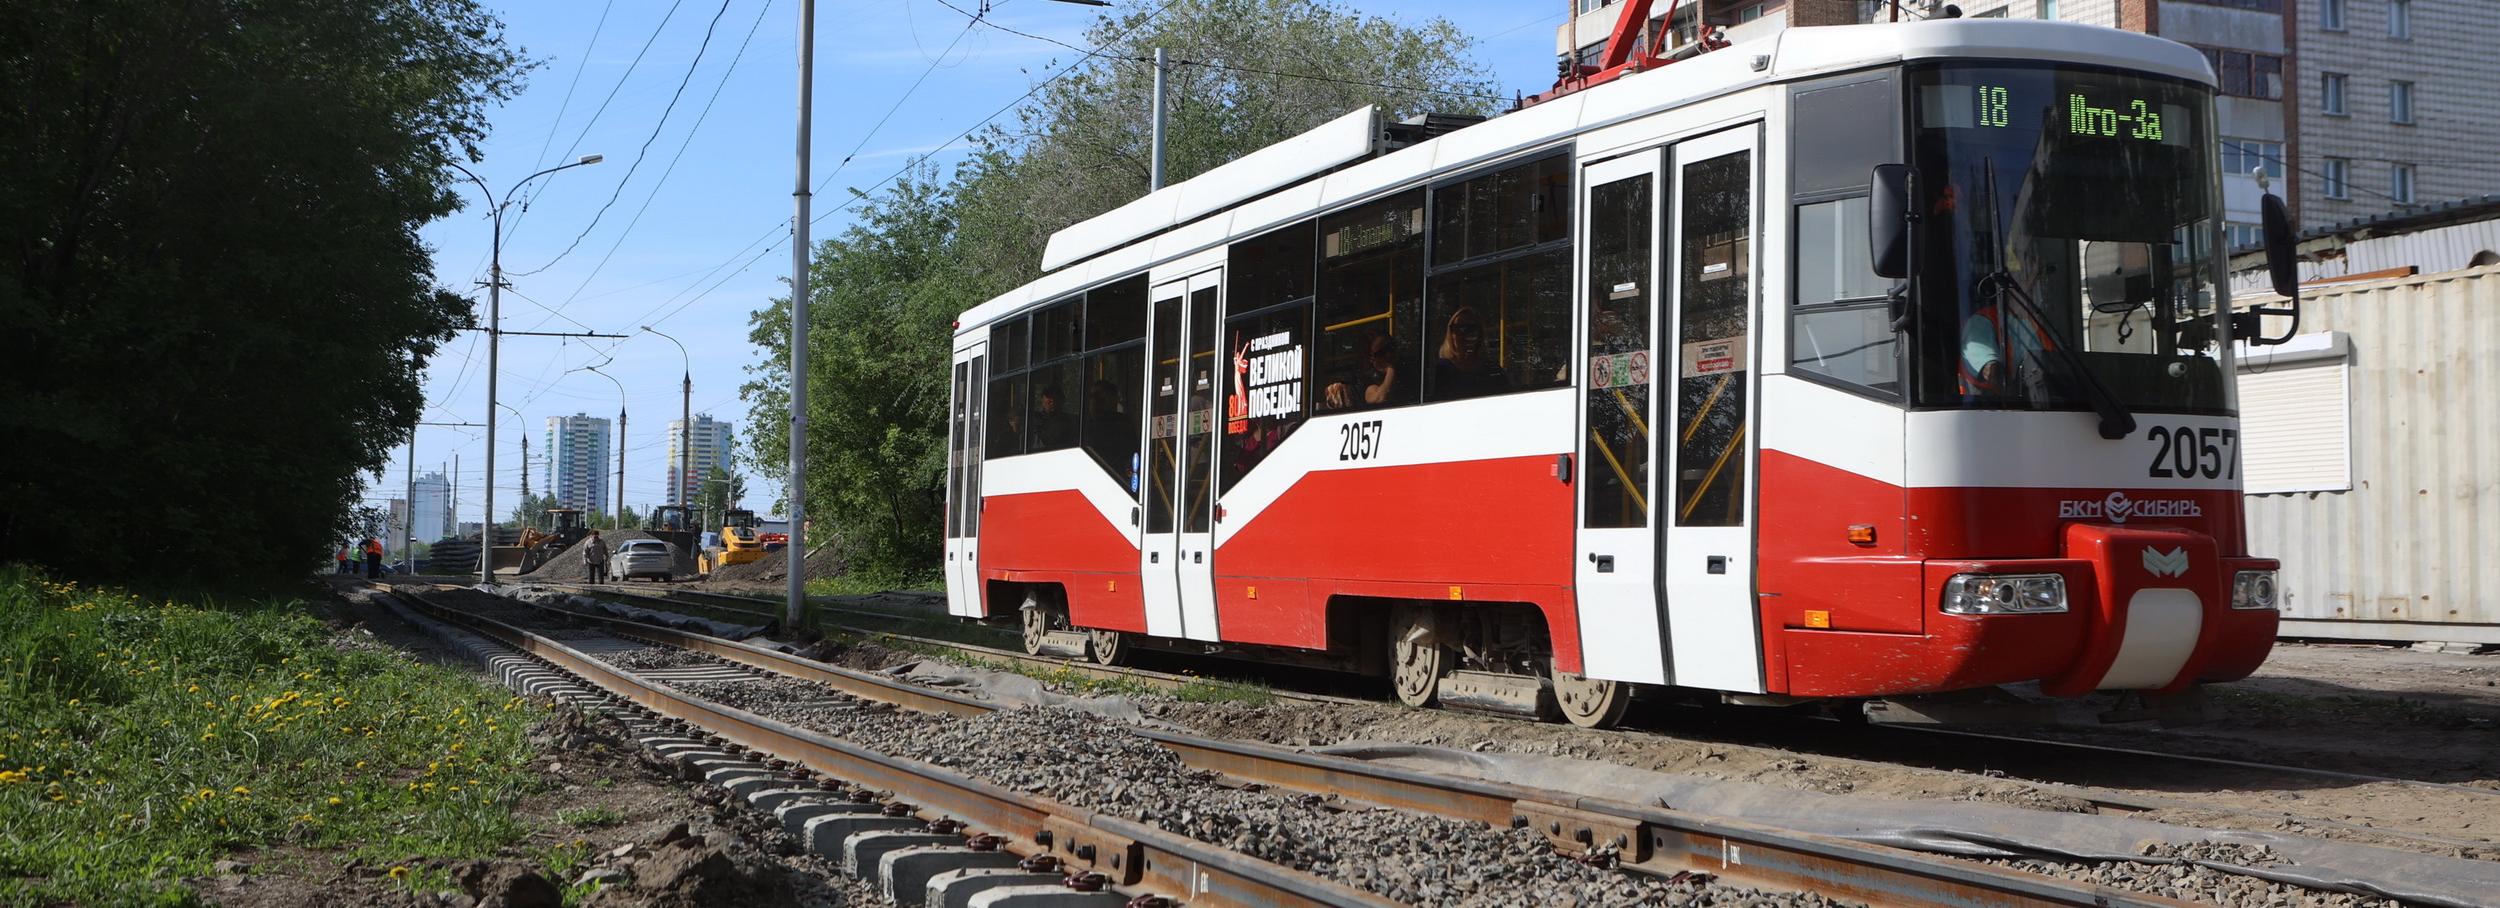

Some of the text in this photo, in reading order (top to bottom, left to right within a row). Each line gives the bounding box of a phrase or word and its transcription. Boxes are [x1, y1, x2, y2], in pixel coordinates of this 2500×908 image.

[1979, 86, 2162, 141] 18 Юго-За
[1249, 344, 1303, 387] ВЕЛИКОЙ
[1248, 381, 1301, 420] ПОБЕДЫ!
[1340, 420, 1382, 461] 2057
[2148, 425, 2238, 480] 2057
[2059, 500, 2202, 518] БКМ СИБИРЬ
